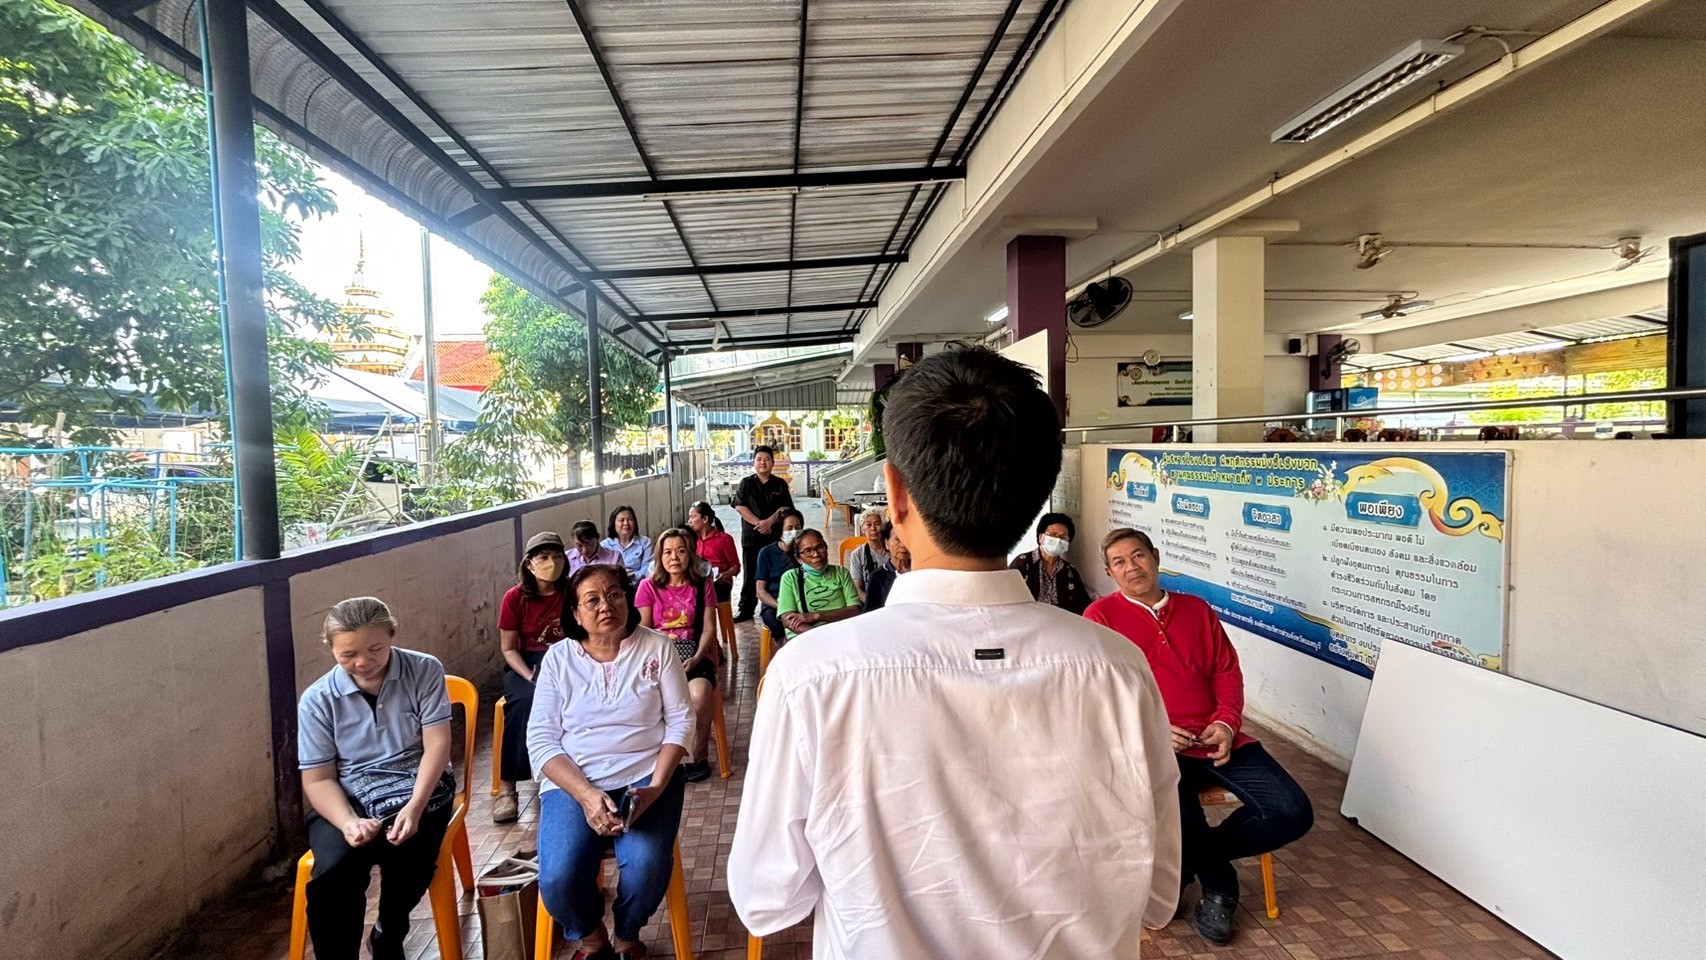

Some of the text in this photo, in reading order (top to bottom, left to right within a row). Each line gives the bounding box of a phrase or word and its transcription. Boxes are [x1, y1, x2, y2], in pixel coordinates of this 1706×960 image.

[1267, 472, 1305, 489] ประการ
[1177, 498, 1204, 513] รับผิดชอบ
[1252, 508, 1282, 525] จิตอาสา
[1358, 500, 1403, 518] พอเพียง
[1330, 523, 1392, 540] มีความพอประมาณ
[1396, 533, 1412, 544] พอดี
[1416, 534, 1425, 545] ไม่
[1331, 540, 1477, 573] เบียดเบียนตนเอง สังคม และสิ่งแวดล้อม
[1330, 555, 1390, 575] ปลูกฝังอุดมการณ์
[1395, 569, 1459, 588] คุณธรรมในการ
[1331, 570, 1436, 602] ดำรงชีวิตร่วมกันในสังคม โดย
[1331, 585, 1431, 617] กระบวนการสหกรณ์โรงเรียน
[1330, 600, 1375, 620] บริหารจัดการ
[1377, 615, 1462, 645] และประสานกับทุกภาค
[1330, 628, 1357, 645] บุคลากร
